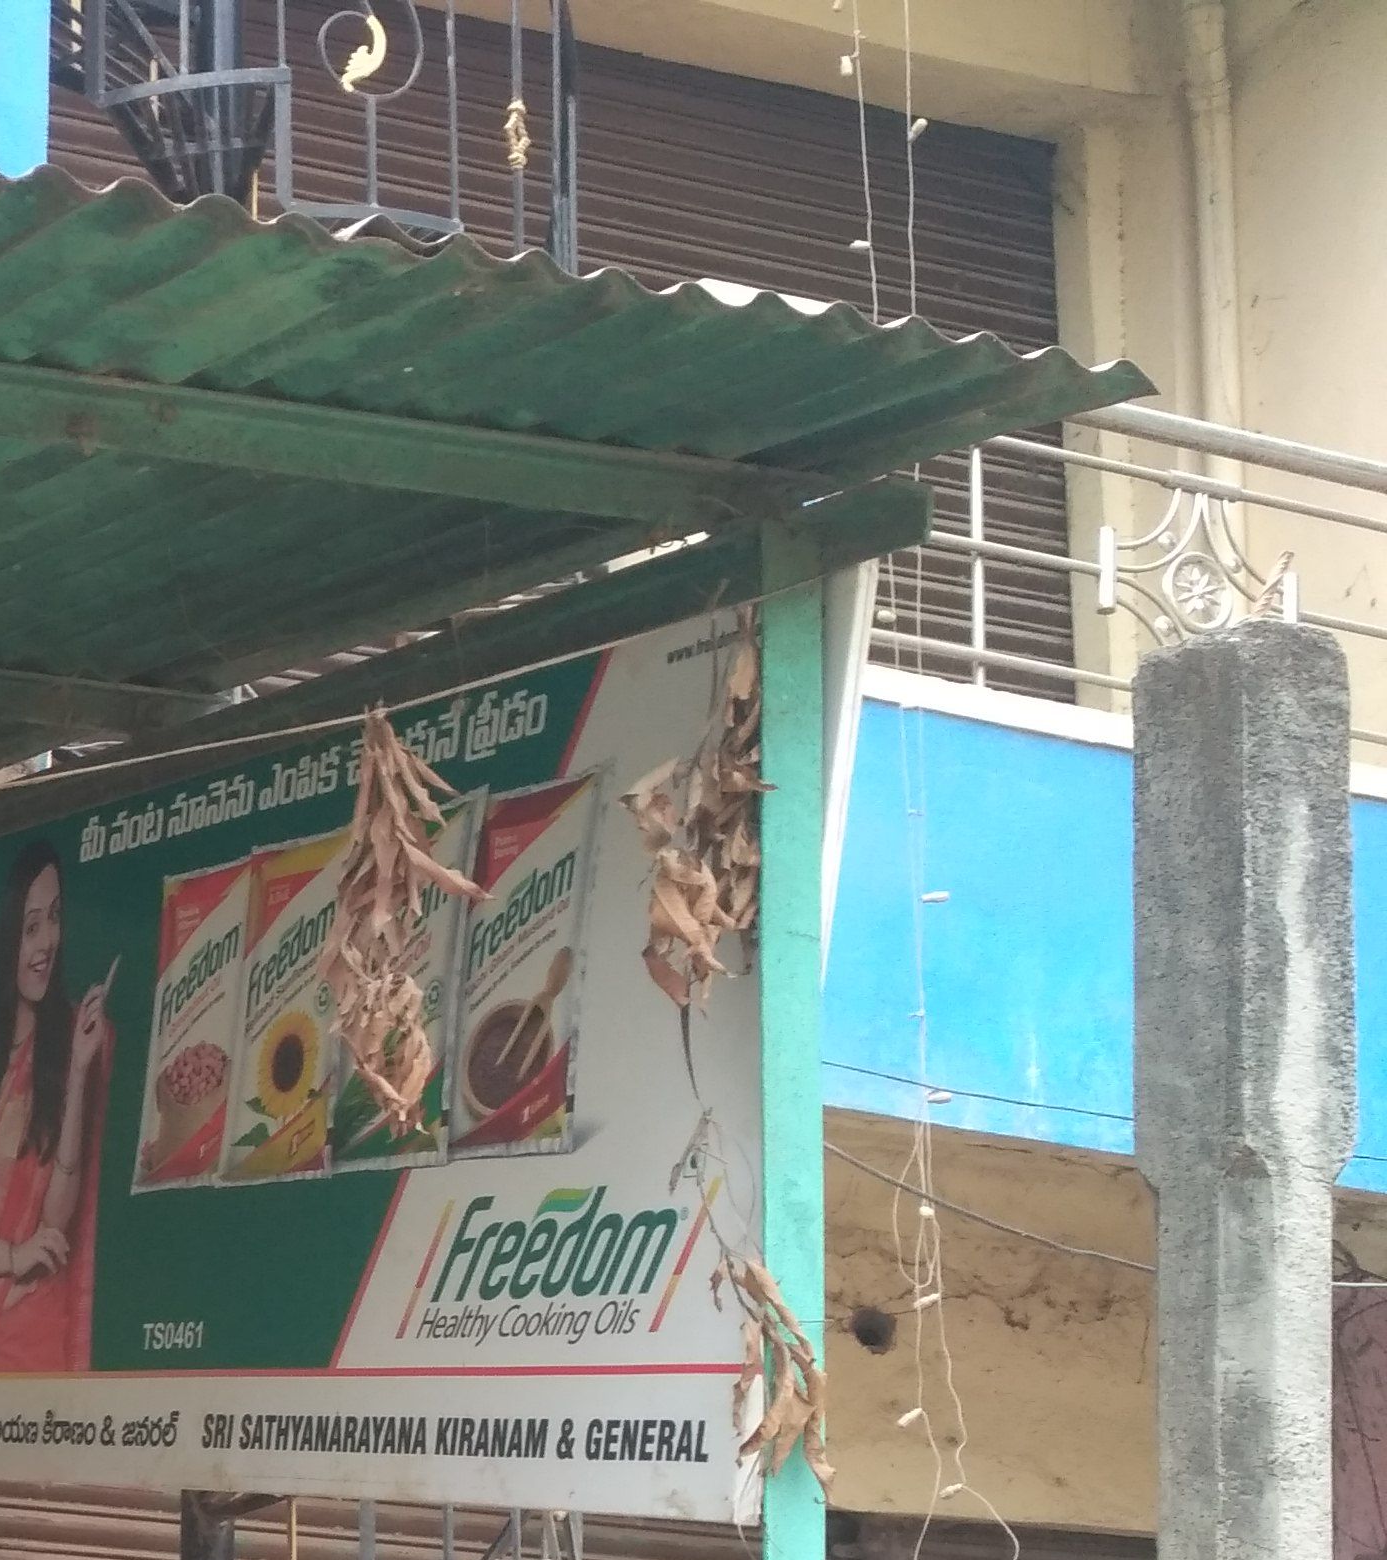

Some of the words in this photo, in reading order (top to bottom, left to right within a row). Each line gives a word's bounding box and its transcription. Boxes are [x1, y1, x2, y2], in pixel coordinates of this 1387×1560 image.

[108, 802, 165, 854] వంట
[258, 745, 342, 811] ఎంపిక
[245, 900, 336, 1018] Freedom
[467, 851, 577, 981] Freedom
[157, 921, 242, 1037] Freedom
[430, 1185, 677, 1302] Freedom
[143, 1321, 205, 1350] TS0461
[417, 1305, 498, 1347] Healthy
[498, 1302, 592, 1345] Cooking
[594, 1299, 640, 1336] Oils
[100, 1414, 116, 1446] &
[121, 1410, 180, 1447] జనరల్
[202, 1413, 234, 1449] SRI
[238, 1413, 426, 1455] SATHYANARAYANA
[434, 1416, 549, 1459] KIRANAM
[556, 1417, 576, 1460] &
[584, 1418, 709, 1463] GENERAL
